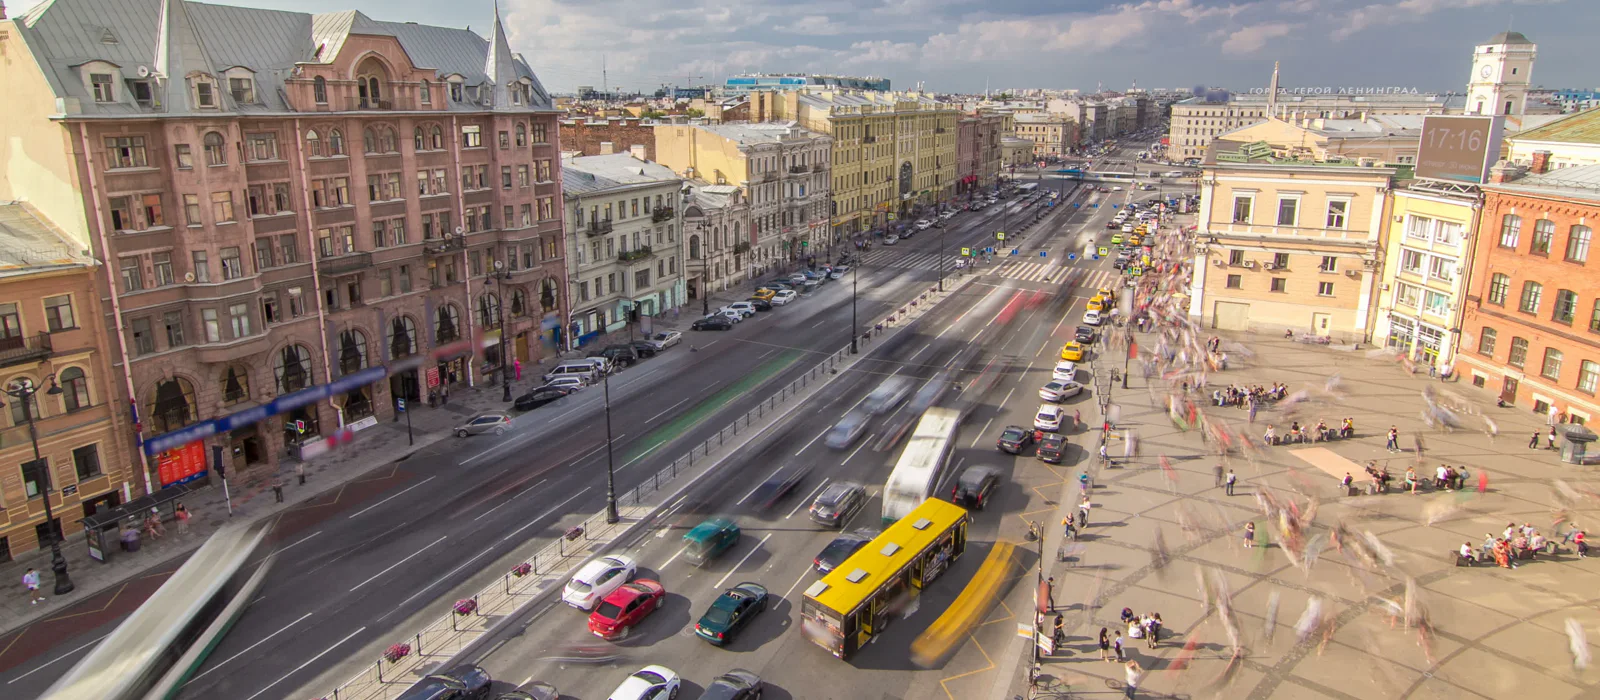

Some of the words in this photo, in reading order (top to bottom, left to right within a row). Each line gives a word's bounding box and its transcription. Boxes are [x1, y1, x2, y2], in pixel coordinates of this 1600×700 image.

[1250, 86, 1331, 95] ГОРД-ГЕРОЙ
[1339, 86, 1418, 95] ЛЕНИНГРАД
[1427, 127, 1482, 152] 17:16
